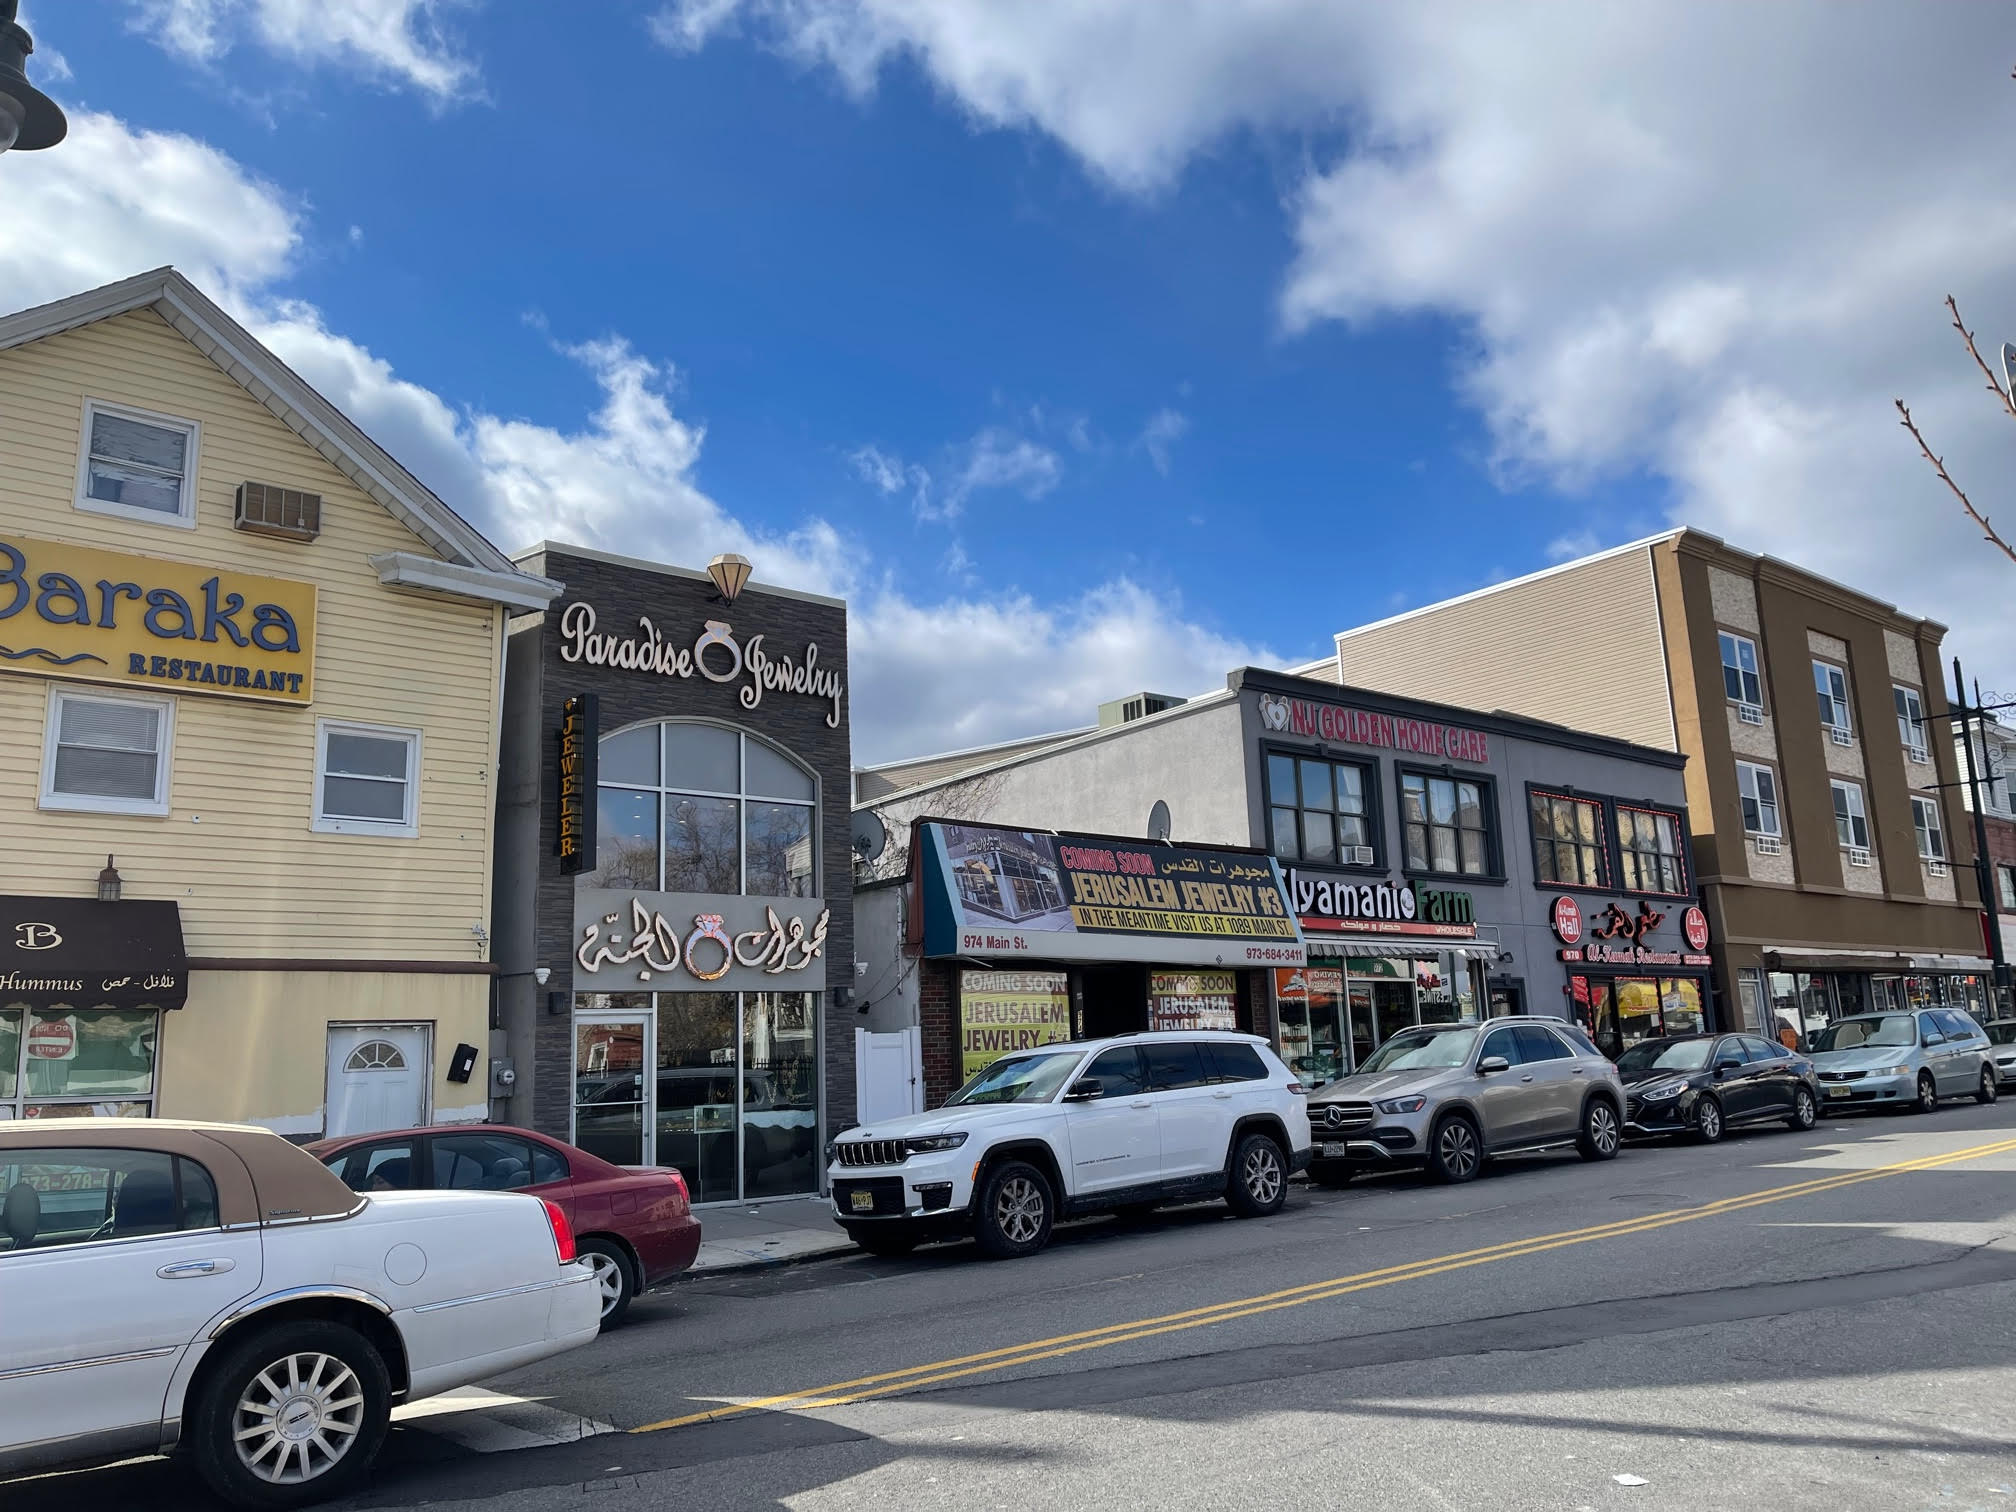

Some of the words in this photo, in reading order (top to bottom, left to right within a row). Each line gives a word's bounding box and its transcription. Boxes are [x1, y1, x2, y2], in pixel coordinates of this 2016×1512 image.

[129, 653, 304, 694] RESTAURANT
[560, 601, 694, 678] Paradise
[739, 634, 842, 728] Jewelry
[1290, 700, 1316, 736] NJ
[1321, 708, 1394, 748] GOLDEN
[1395, 719, 1444, 755] HOME
[1446, 728, 1489, 763] CARE
[560, 715, 575, 857] JEWELER
[1060, 845, 1118, 873] COMING
[1116, 851, 1156, 876] SOON
[1070, 871, 1182, 910] JERUSALEM
[1180, 880, 1258, 914] JEWELRY
[1257, 886, 1284, 916] #3
[1415, 879, 1475, 923] Farm
[1078, 907, 1094, 926] IN
[1092, 909, 1117, 927] THE
[1115, 910, 1173, 930] MEANTIME
[1171, 914, 1198, 932] VISIT
[1199, 916, 1214, 932] US
[1214, 917, 1227, 933] AT
[1226, 917, 1253, 934] 1089
[1251, 918, 1278, 936] MAIN
[1276, 920, 1293, 936] ST.
[1559, 916, 1579, 935] Hall
[15, 922, 63, 950] B
[963, 934, 983, 949] 974
[986, 935, 1010, 949] Main
[1013, 936, 1028, 949] St.
[1565, 950, 1580, 960] 970
[0, 970, 83, 991] Hummus
[961, 973, 1021, 991] COMING
[1025, 974, 1067, 992] SOON
[1201, 975, 1234, 991] SOON
[965, 1000, 1065, 1024] JERUSALEM
[1158, 996, 1230, 1015] JERUSALEM
[963, 1029, 1041, 1052] JEWELRY
